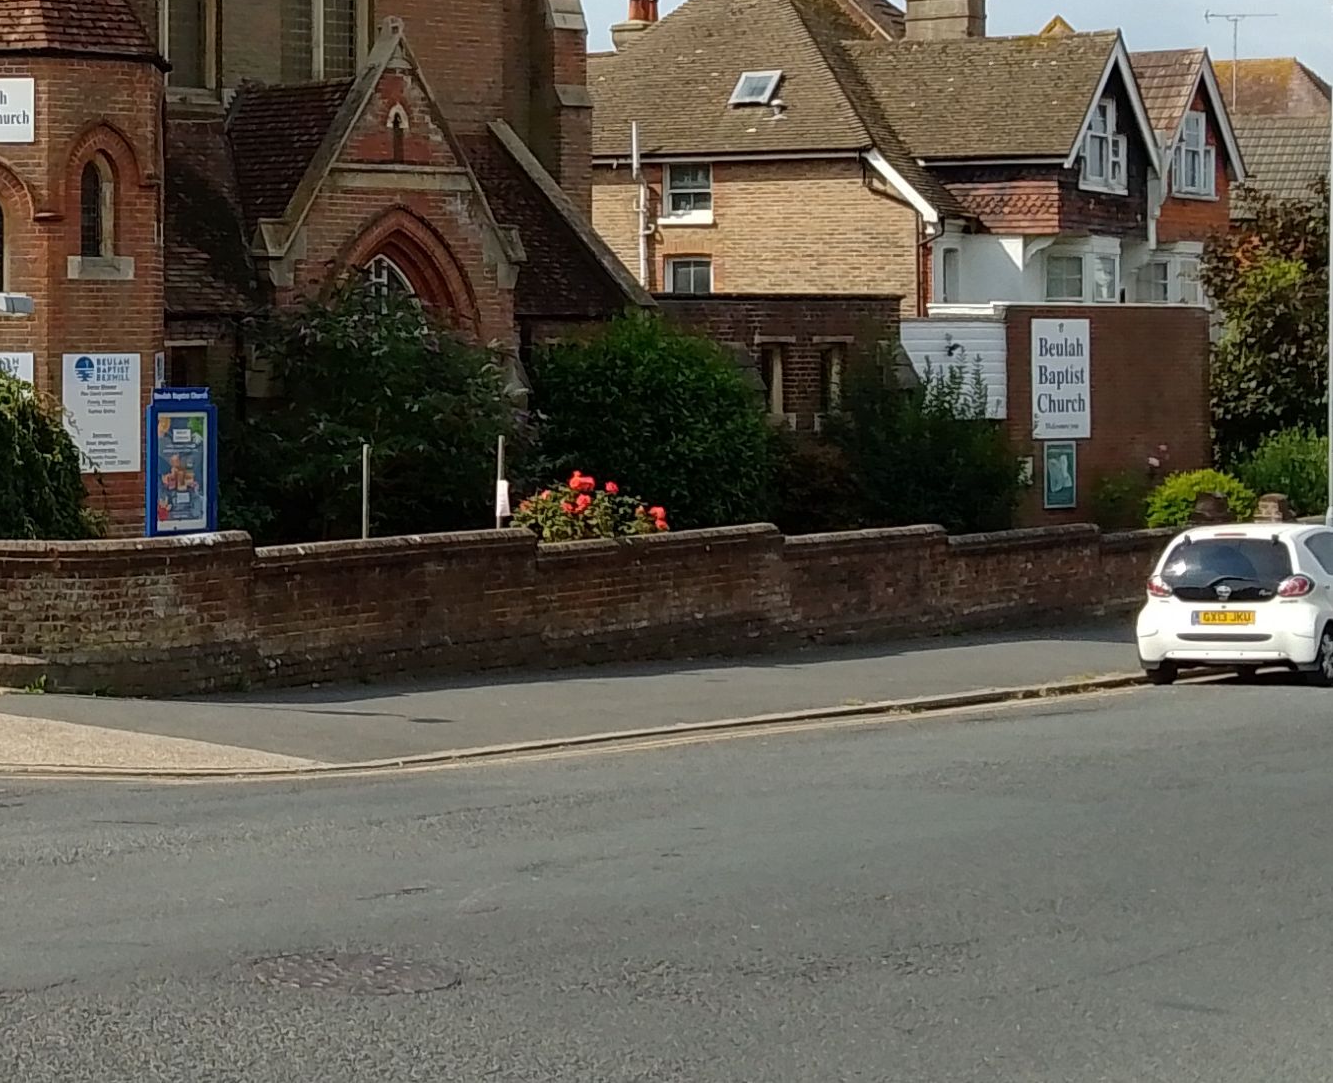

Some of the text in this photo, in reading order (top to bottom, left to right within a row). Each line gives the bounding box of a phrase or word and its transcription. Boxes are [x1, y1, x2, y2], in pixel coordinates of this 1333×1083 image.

[1038, 337, 1084, 357] Beulah
[1038, 364, 1085, 390] Baptist
[1037, 392, 1086, 413] Church
